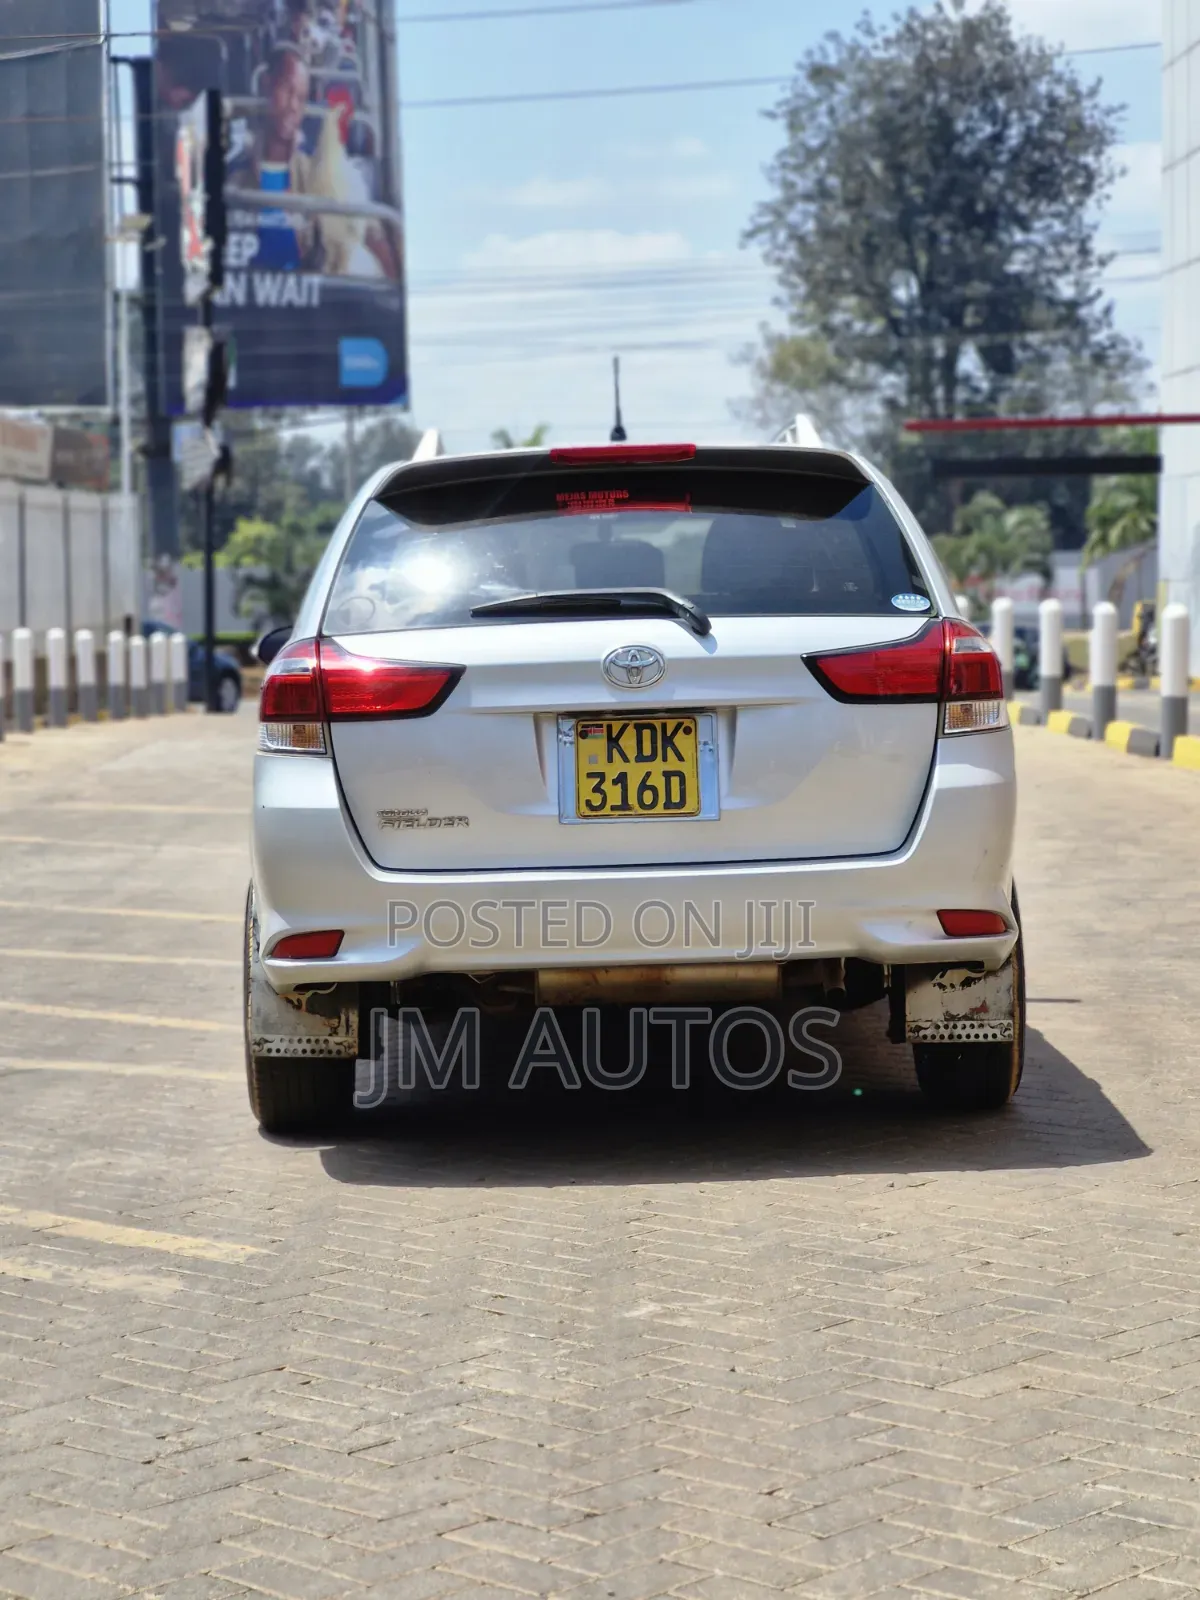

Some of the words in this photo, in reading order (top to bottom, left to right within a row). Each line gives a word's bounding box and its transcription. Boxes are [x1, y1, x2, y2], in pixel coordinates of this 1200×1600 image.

[252, 271, 321, 308] WAIT
[606, 721, 686, 764] KDK
[585, 770, 687, 812] 316D
[378, 815, 470, 831] FIELDER
